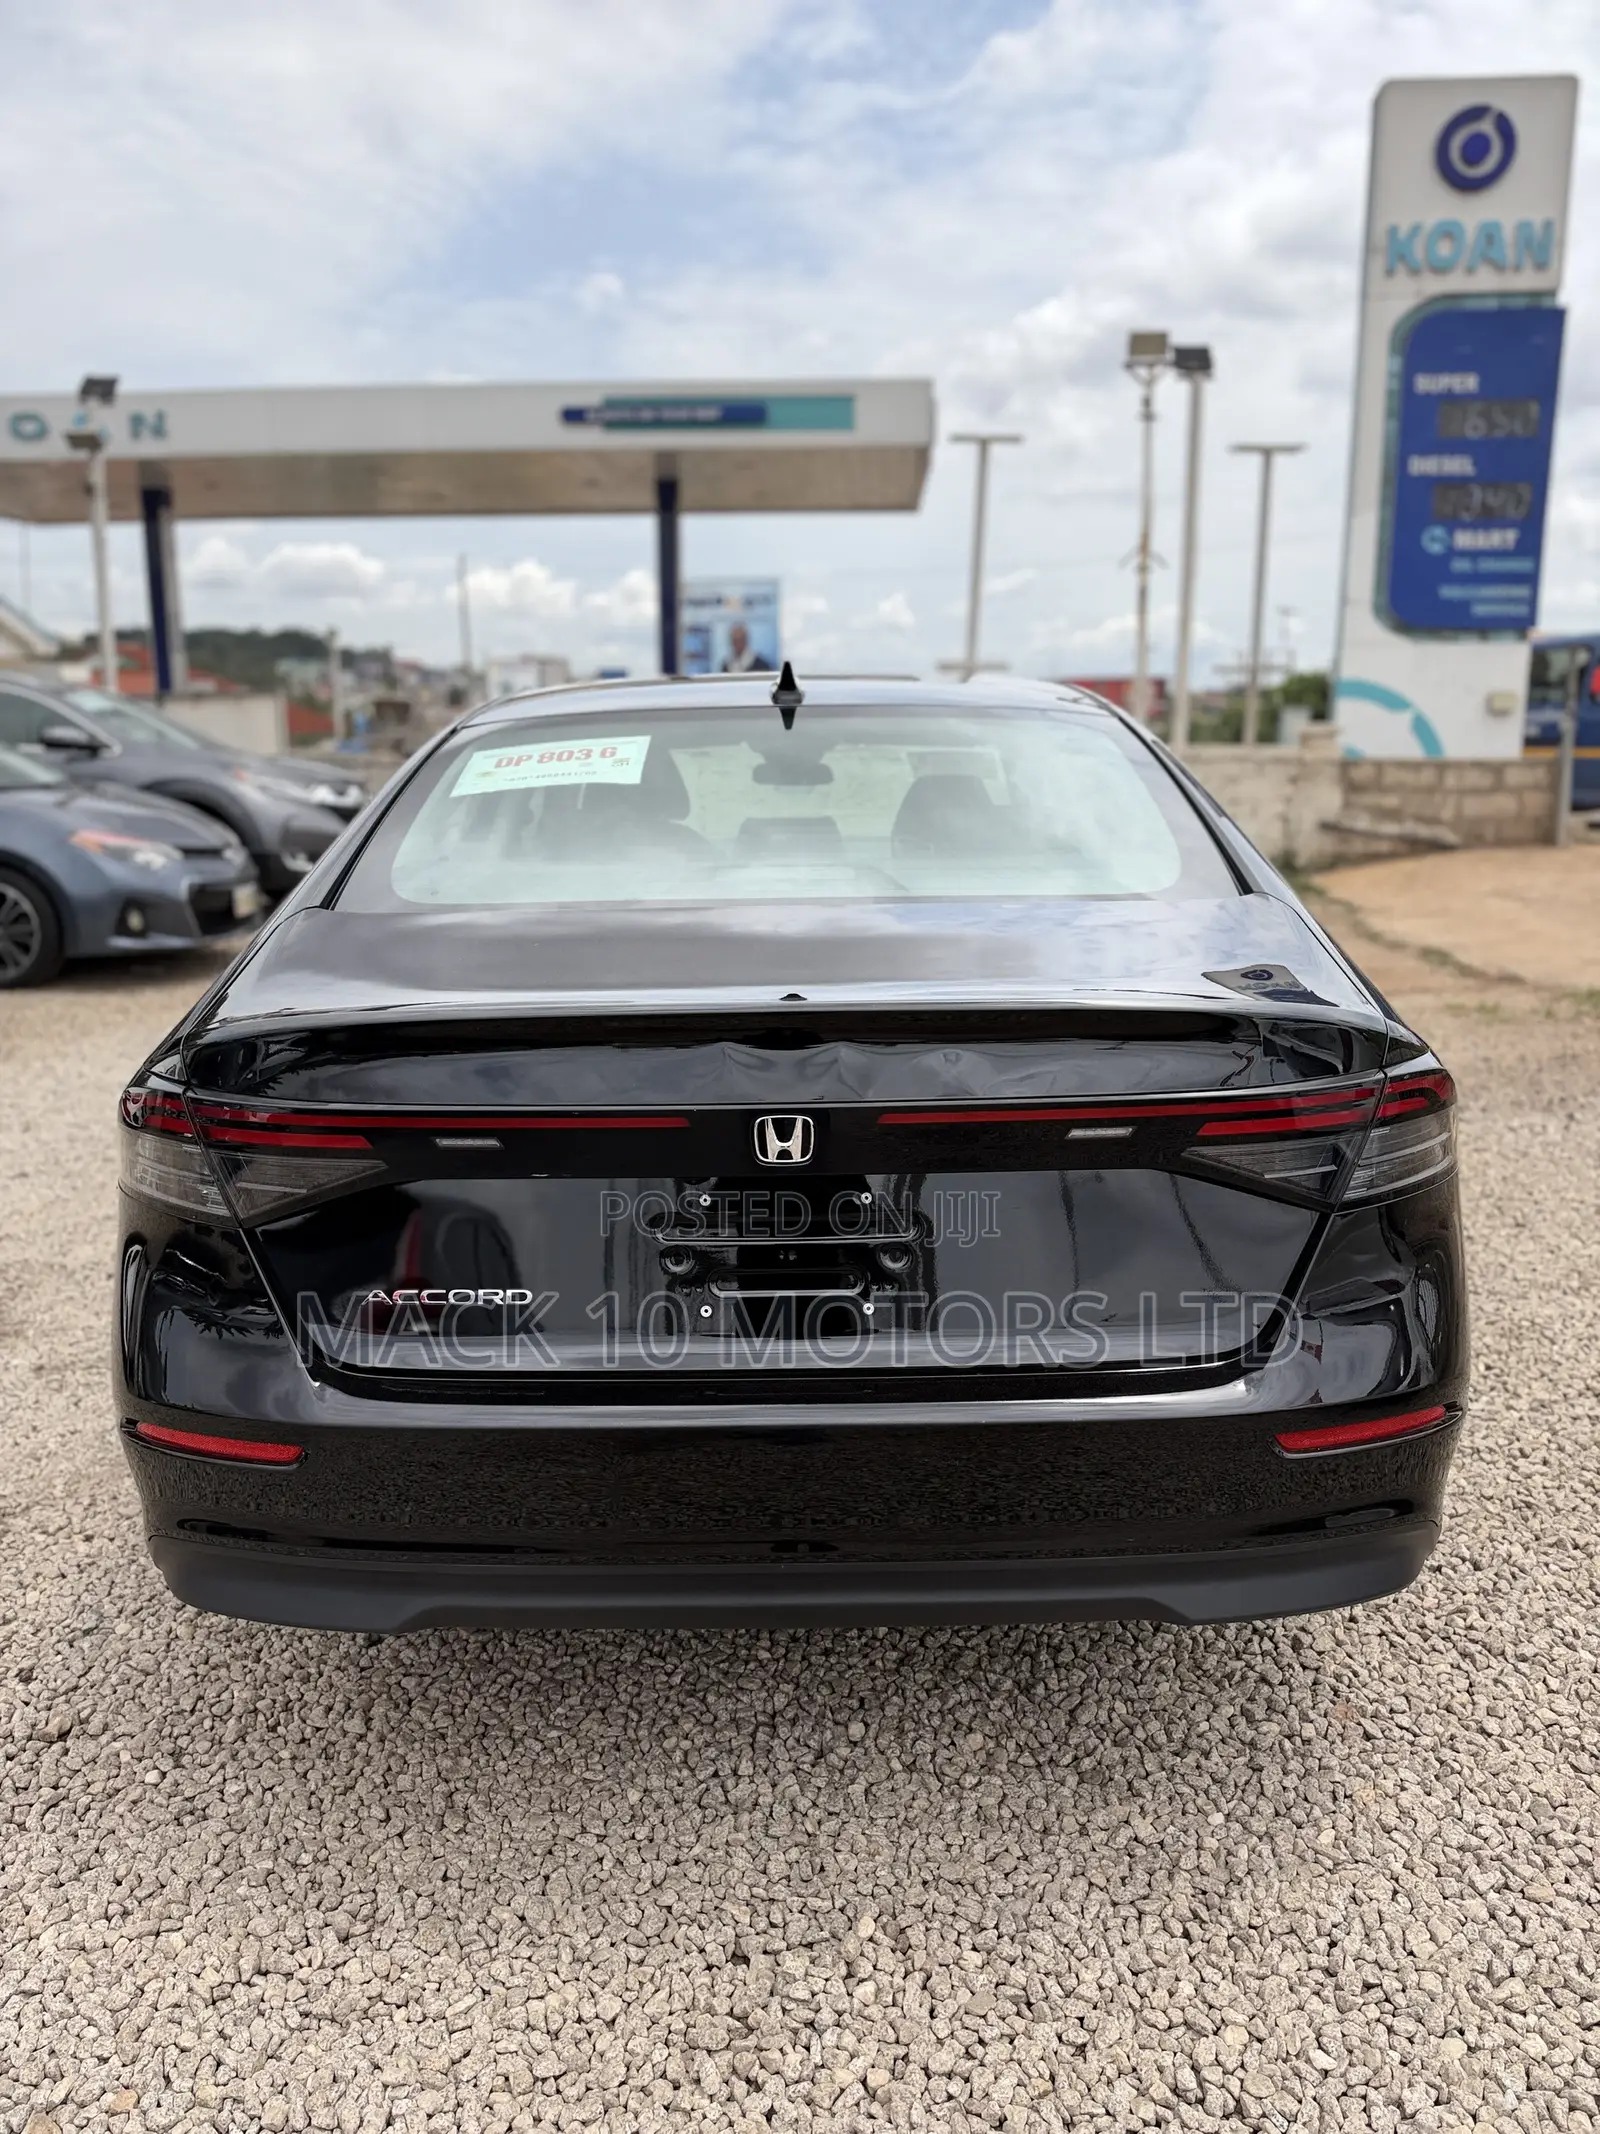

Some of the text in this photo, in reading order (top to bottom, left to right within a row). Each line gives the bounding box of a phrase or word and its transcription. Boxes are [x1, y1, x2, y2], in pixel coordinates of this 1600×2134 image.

[1386, 218, 1555, 277] KOAN
[1414, 372, 1479, 394] SUPER
[1408, 454, 1476, 477] DIESEL
[537, 748, 593, 764] 803
[360, 1289, 533, 1305] ACCORD
